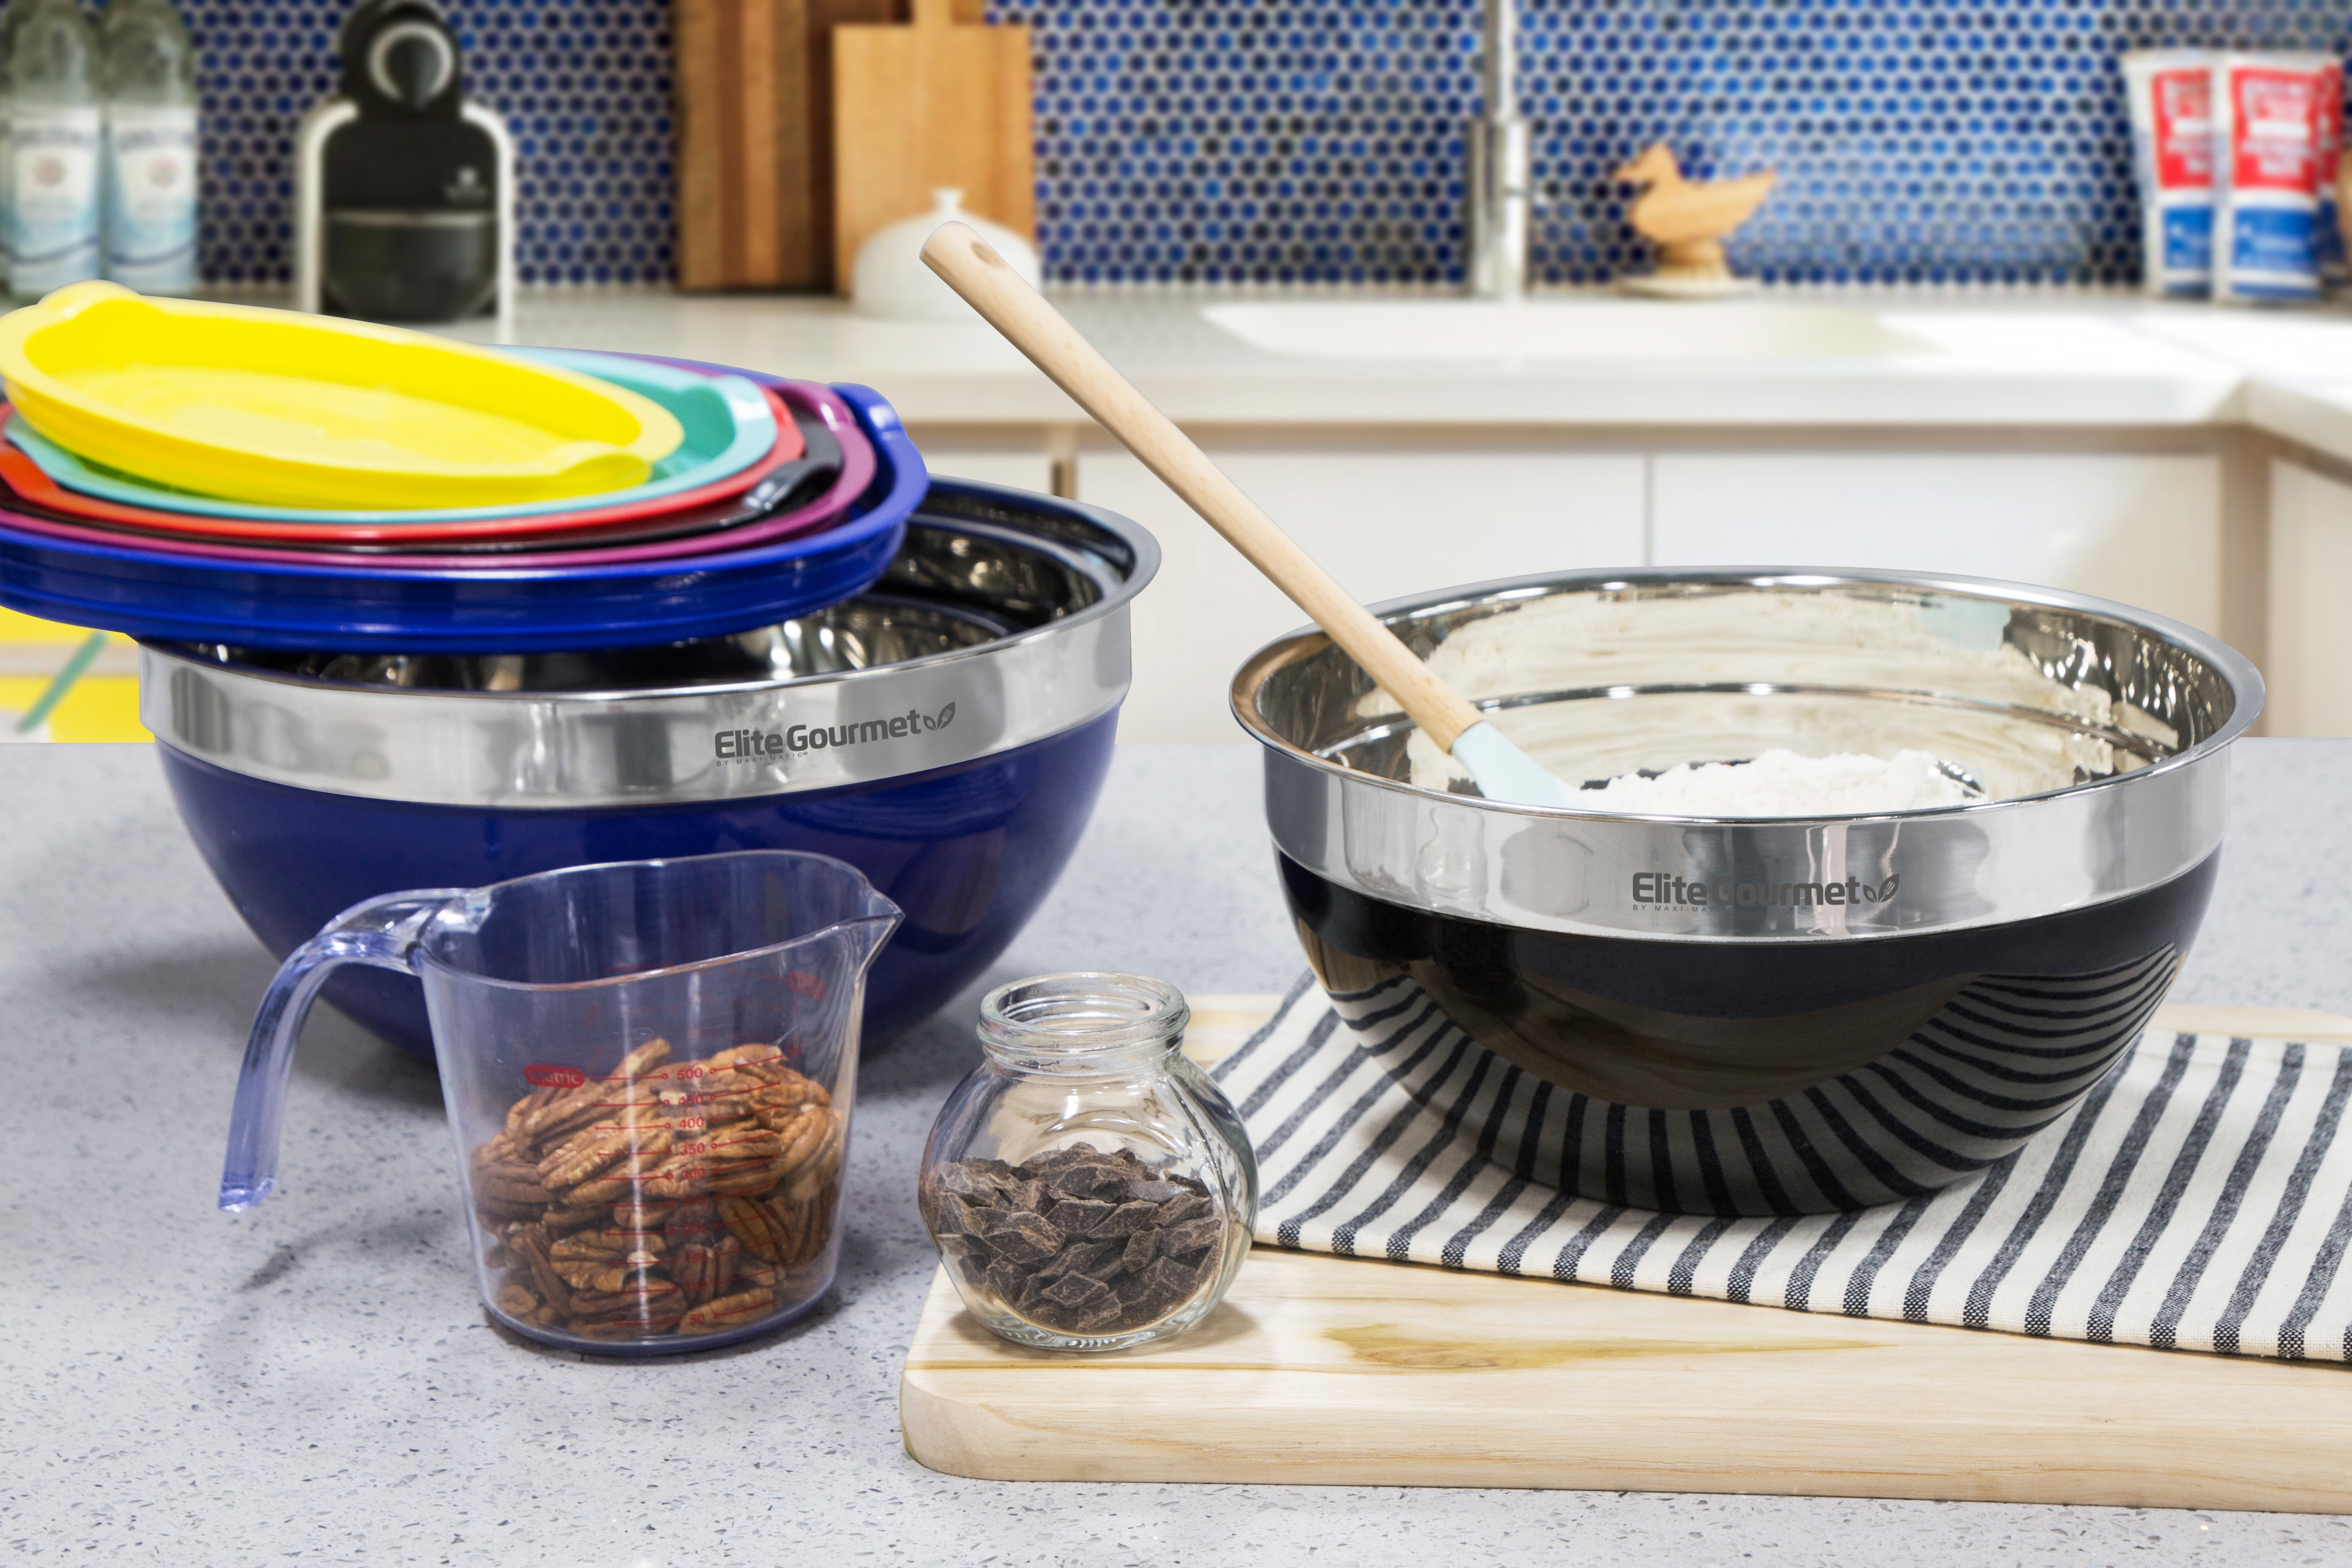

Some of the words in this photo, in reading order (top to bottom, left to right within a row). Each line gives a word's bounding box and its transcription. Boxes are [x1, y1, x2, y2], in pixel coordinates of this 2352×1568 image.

[715, 729, 783, 758] Elite
[787, 709, 922, 751] Gourmet
[1633, 872, 1707, 904] Elite
[1712, 876, 1860, 905] Gourmet
[530, 1071, 579, 1084] metric
[677, 1068, 703, 1080] 500
[678, 1094, 703, 1106] 450
[679, 1117, 704, 1128] 400
[680, 1142, 705, 1155] 350
